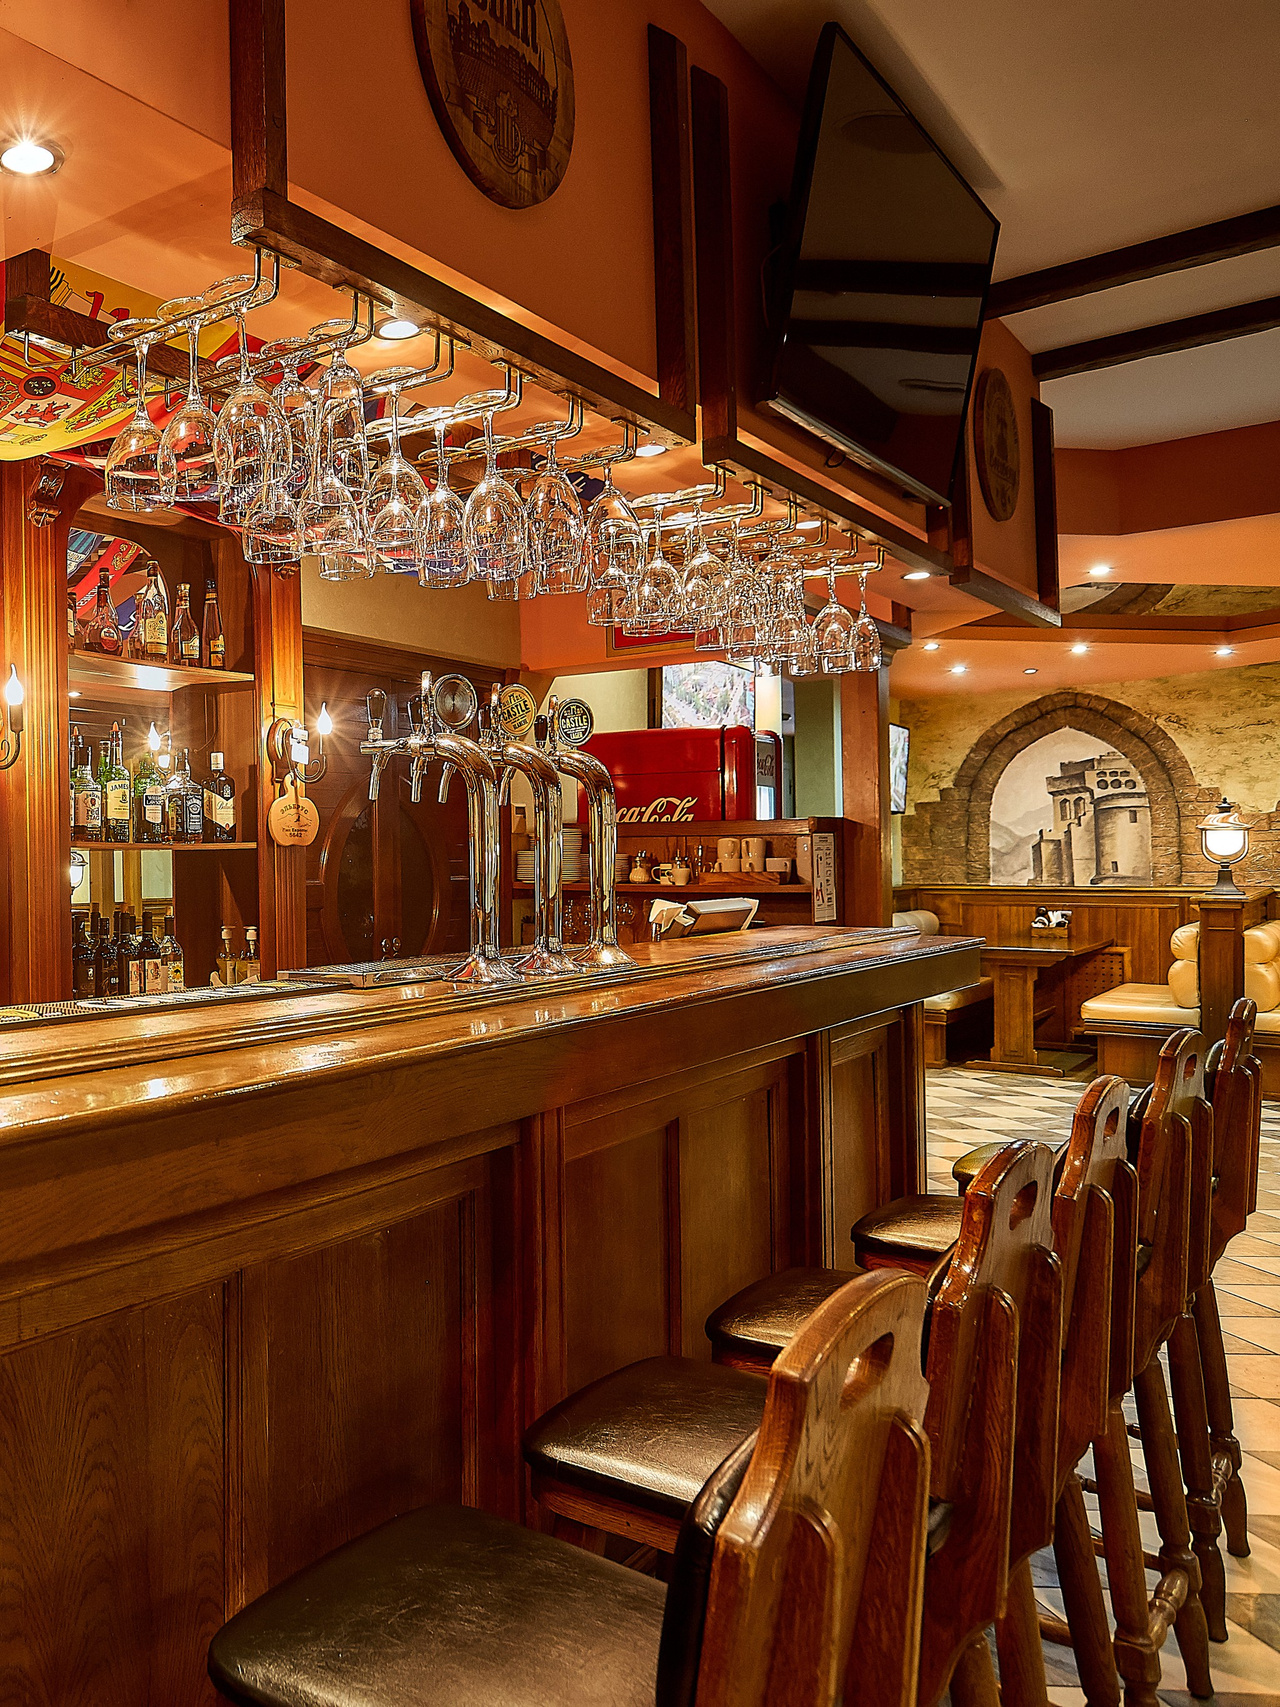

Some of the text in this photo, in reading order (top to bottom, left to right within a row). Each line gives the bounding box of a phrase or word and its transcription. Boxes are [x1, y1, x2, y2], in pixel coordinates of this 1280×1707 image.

[502, 700, 530, 721] CASTLE
[562, 715, 588, 729] CASTLE
[280, 804, 309, 815] ЭЛЬБРУС
